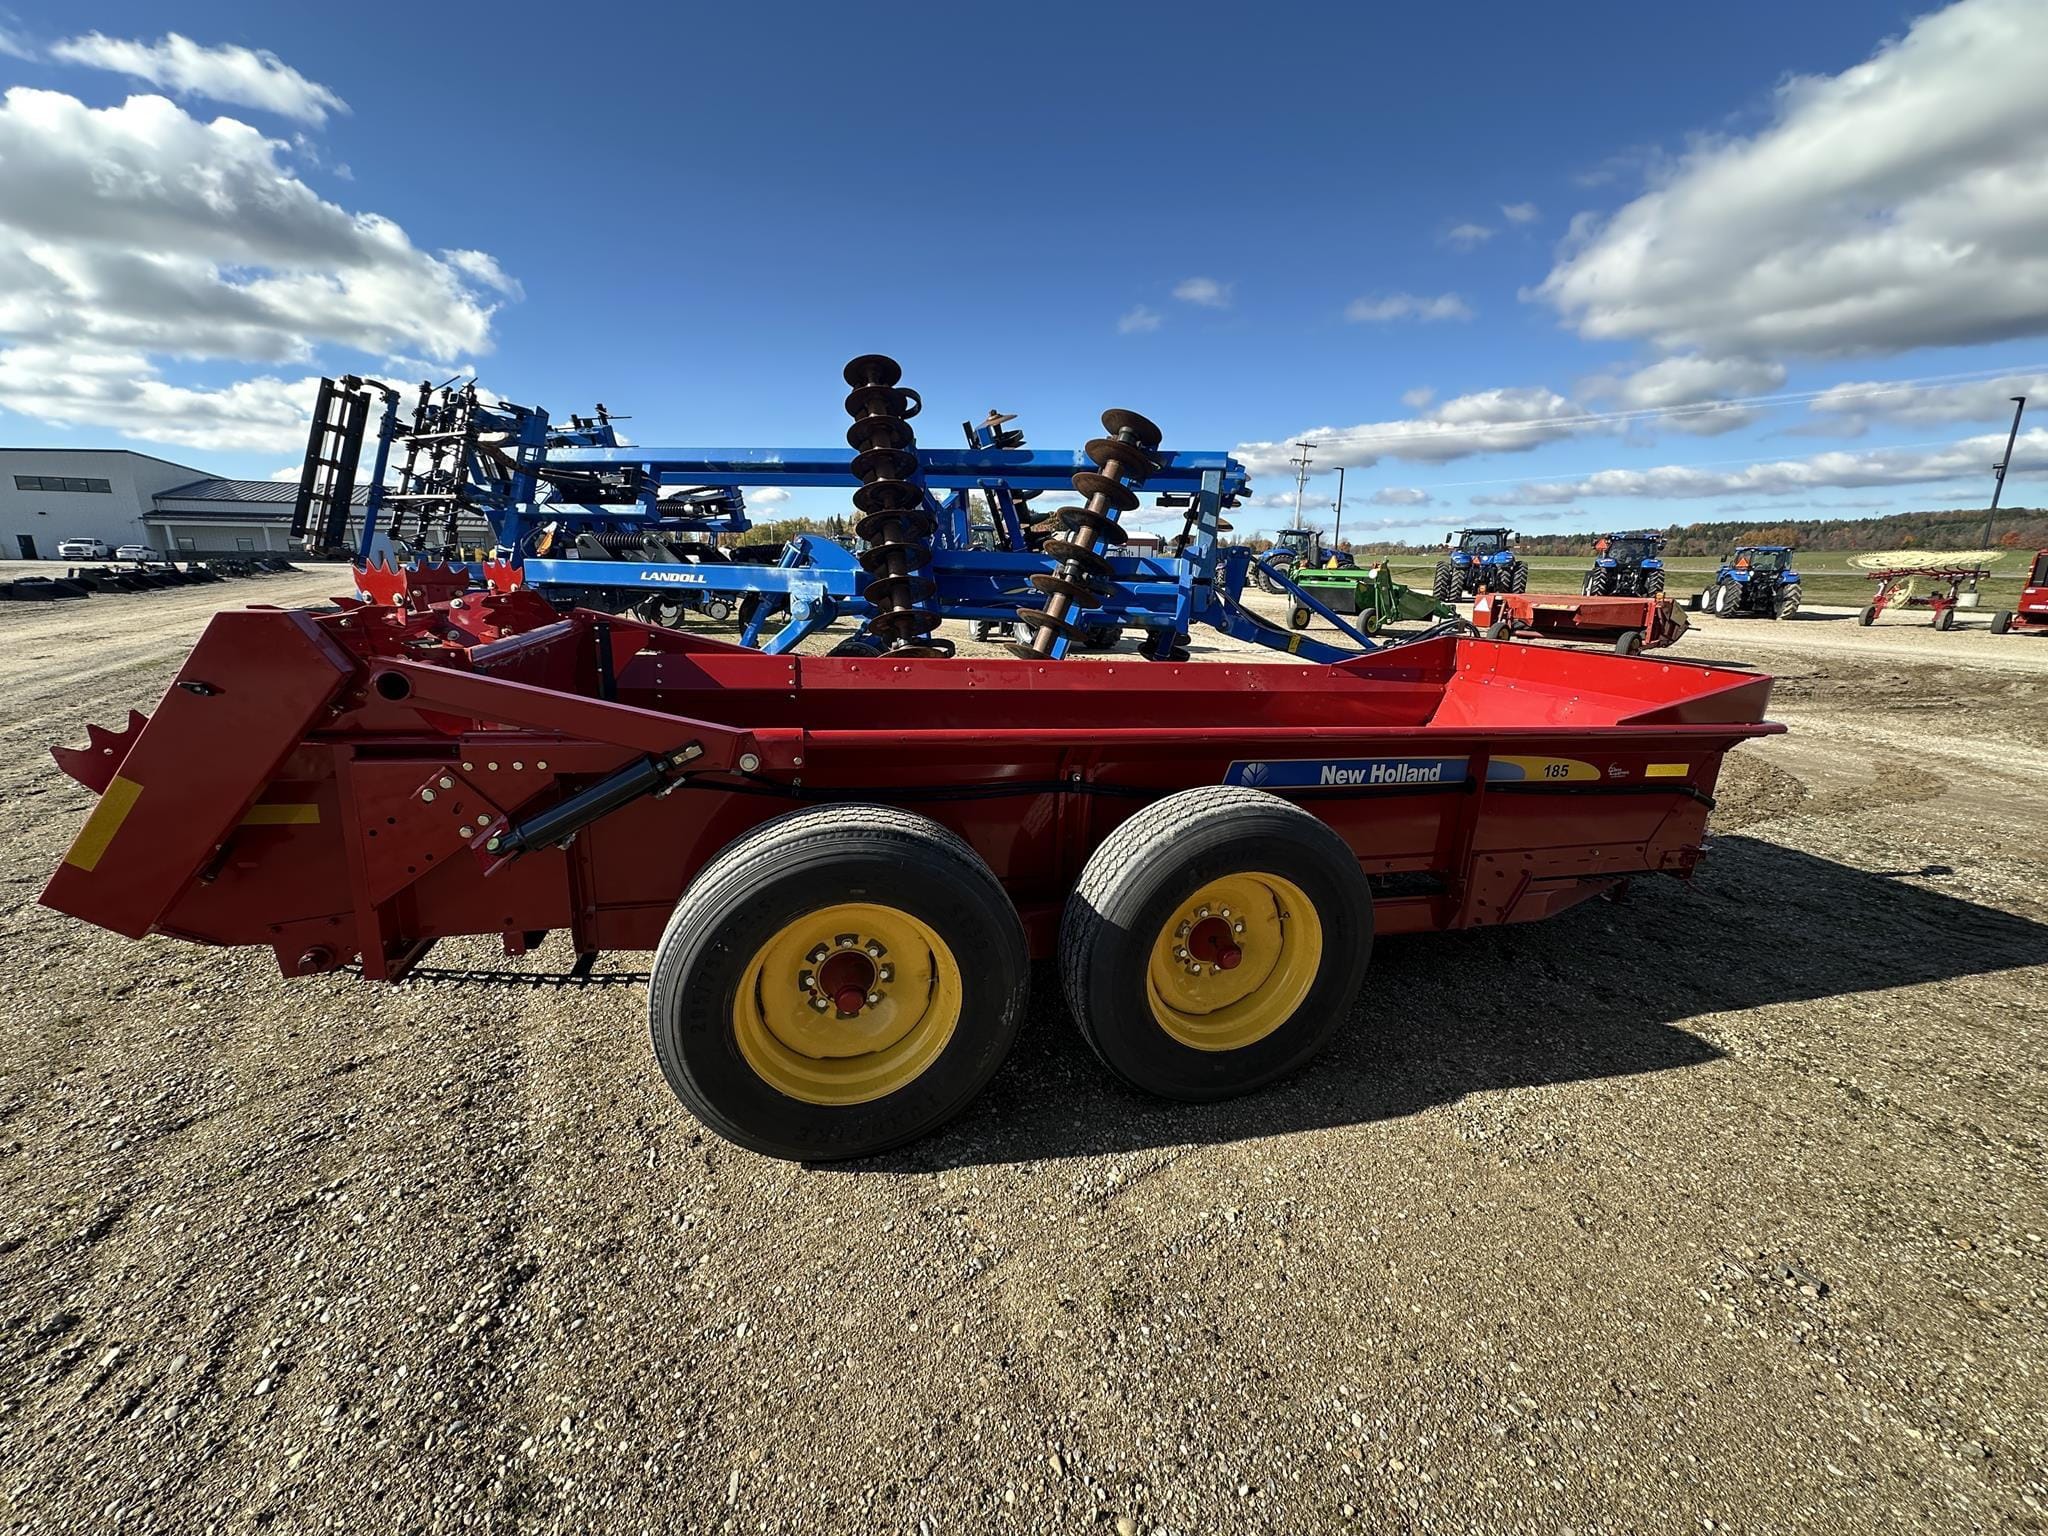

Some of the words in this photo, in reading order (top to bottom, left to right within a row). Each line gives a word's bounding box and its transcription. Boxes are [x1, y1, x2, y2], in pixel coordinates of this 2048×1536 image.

[641, 571, 707, 584] LANDOLL
[1320, 765, 1366, 785] New
[1369, 763, 1442, 783] Holland
[1543, 764, 1569, 778] 185
